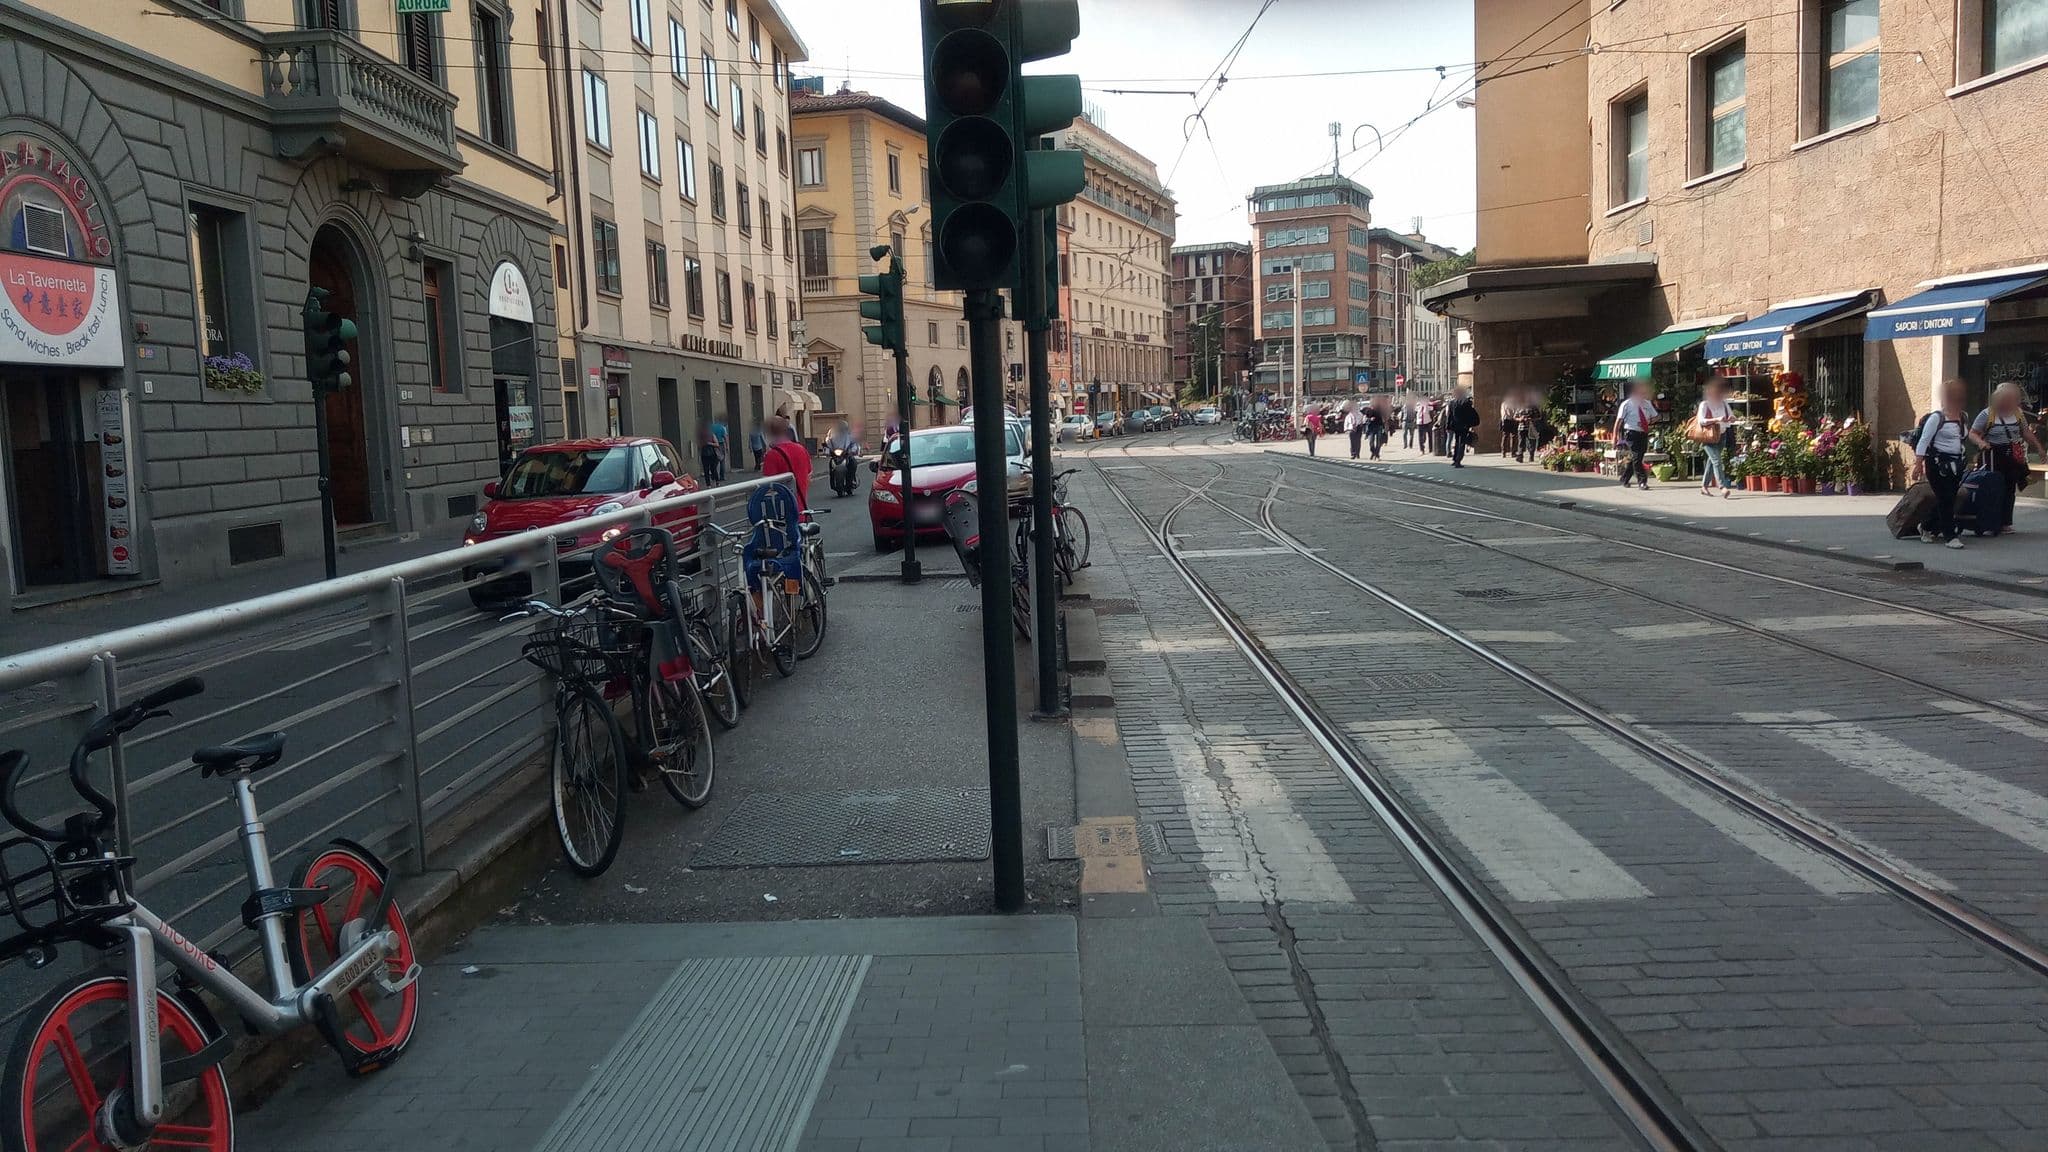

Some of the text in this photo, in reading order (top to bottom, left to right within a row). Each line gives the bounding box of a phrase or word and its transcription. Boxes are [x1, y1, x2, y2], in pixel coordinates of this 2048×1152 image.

[399, 0, 448, 10] AURORA
[9, 268, 87, 293] La Tavernetta
[1, 273, 108, 357] Sand wiches Break fast Lunch
[1895, 320, 1918, 331] SAPORI
[1607, 363, 1637, 378] FIORAIO
